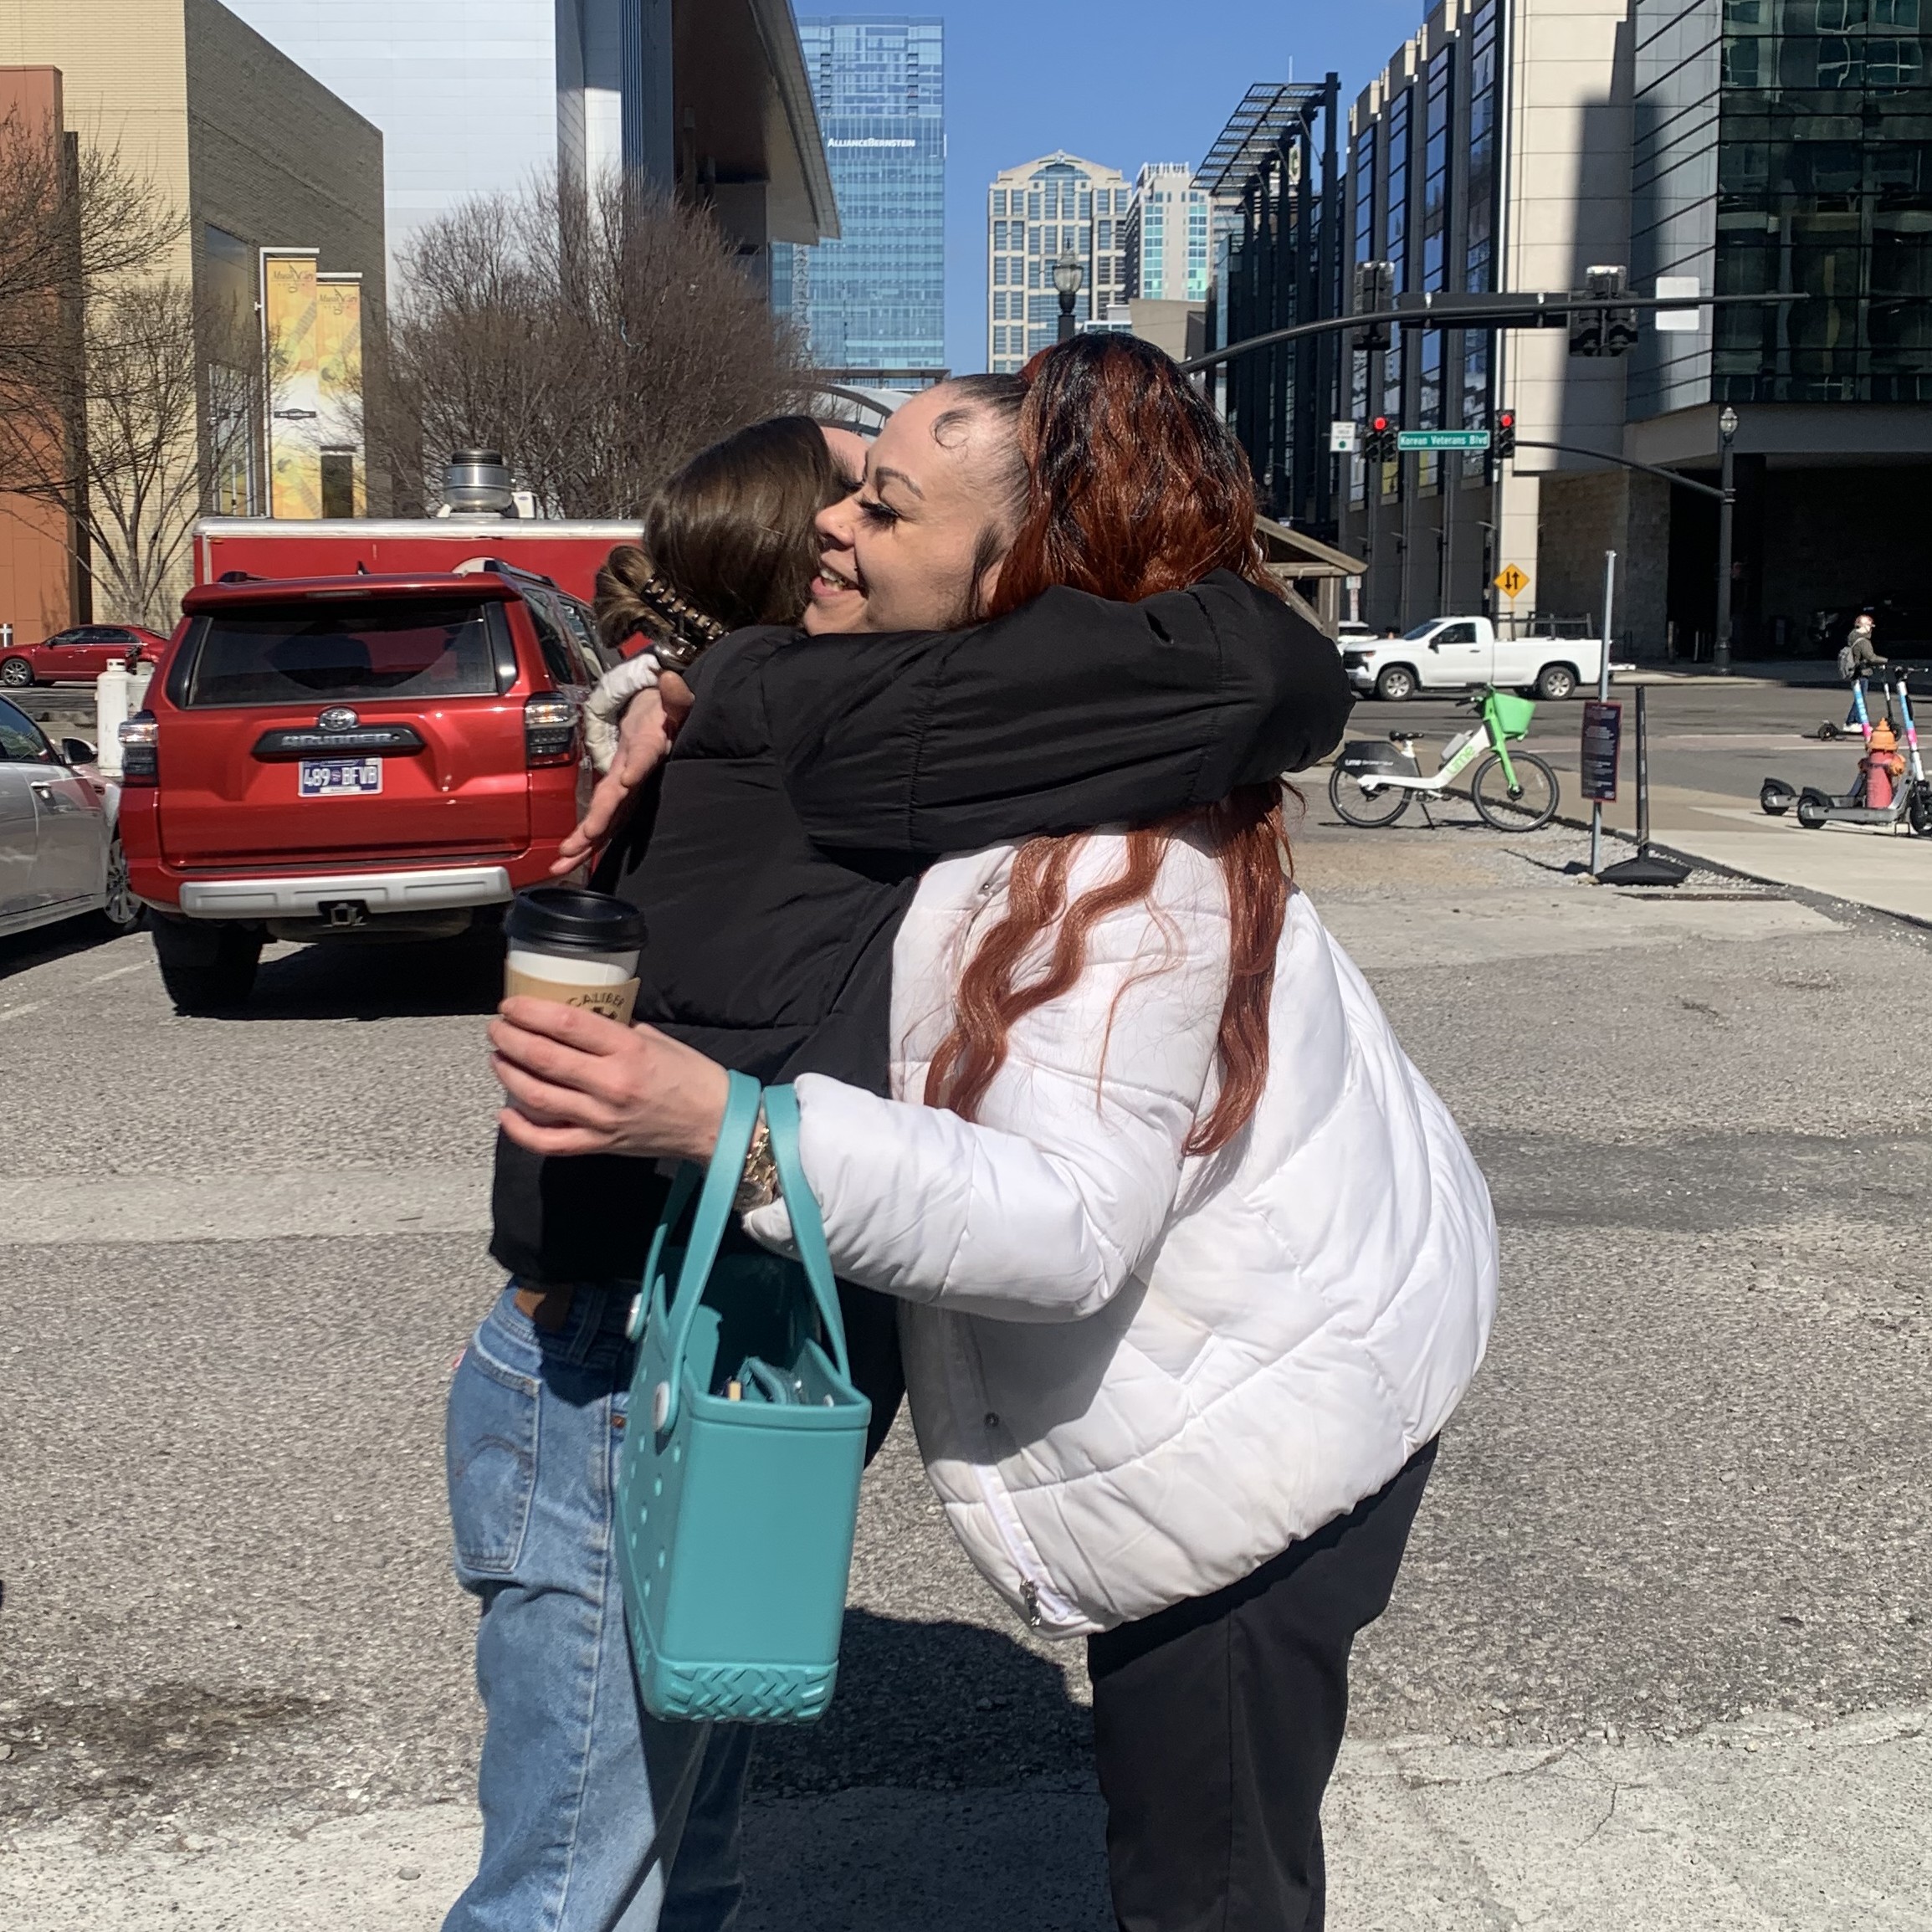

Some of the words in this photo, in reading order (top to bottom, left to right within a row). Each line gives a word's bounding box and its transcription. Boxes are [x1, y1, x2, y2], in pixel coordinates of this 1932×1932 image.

[1400, 436, 1427, 445] Korean
[1431, 436, 1466, 445] Veterans
[1469, 435, 1488, 444] Blvd
[304, 768, 331, 787] 489
